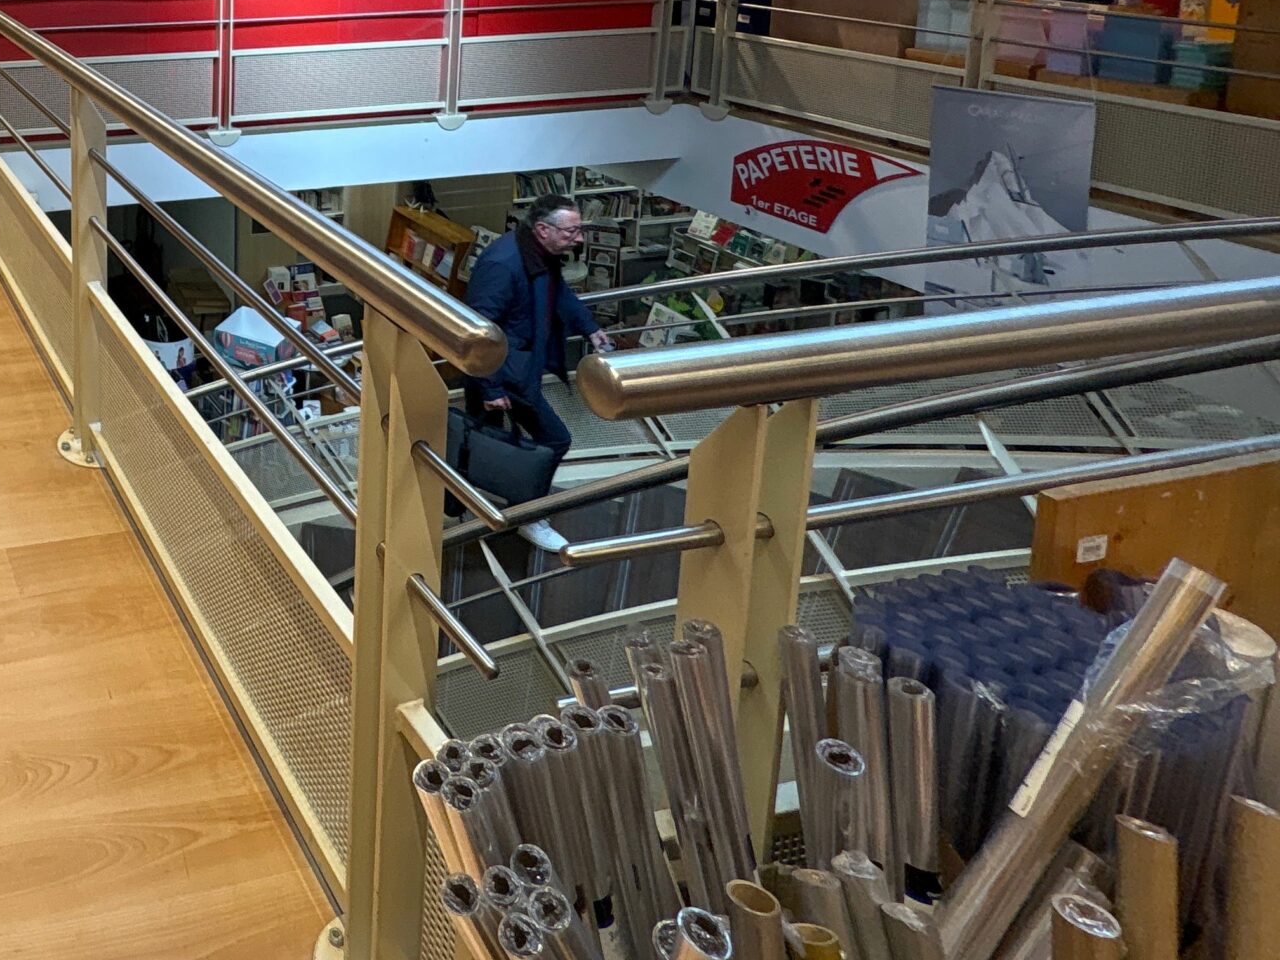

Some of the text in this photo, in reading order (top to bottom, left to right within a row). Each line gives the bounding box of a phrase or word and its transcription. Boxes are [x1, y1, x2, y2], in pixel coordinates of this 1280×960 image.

[735, 144, 862, 190] PAPETERIE
[750, 194, 818, 228] 1er ETAGE
